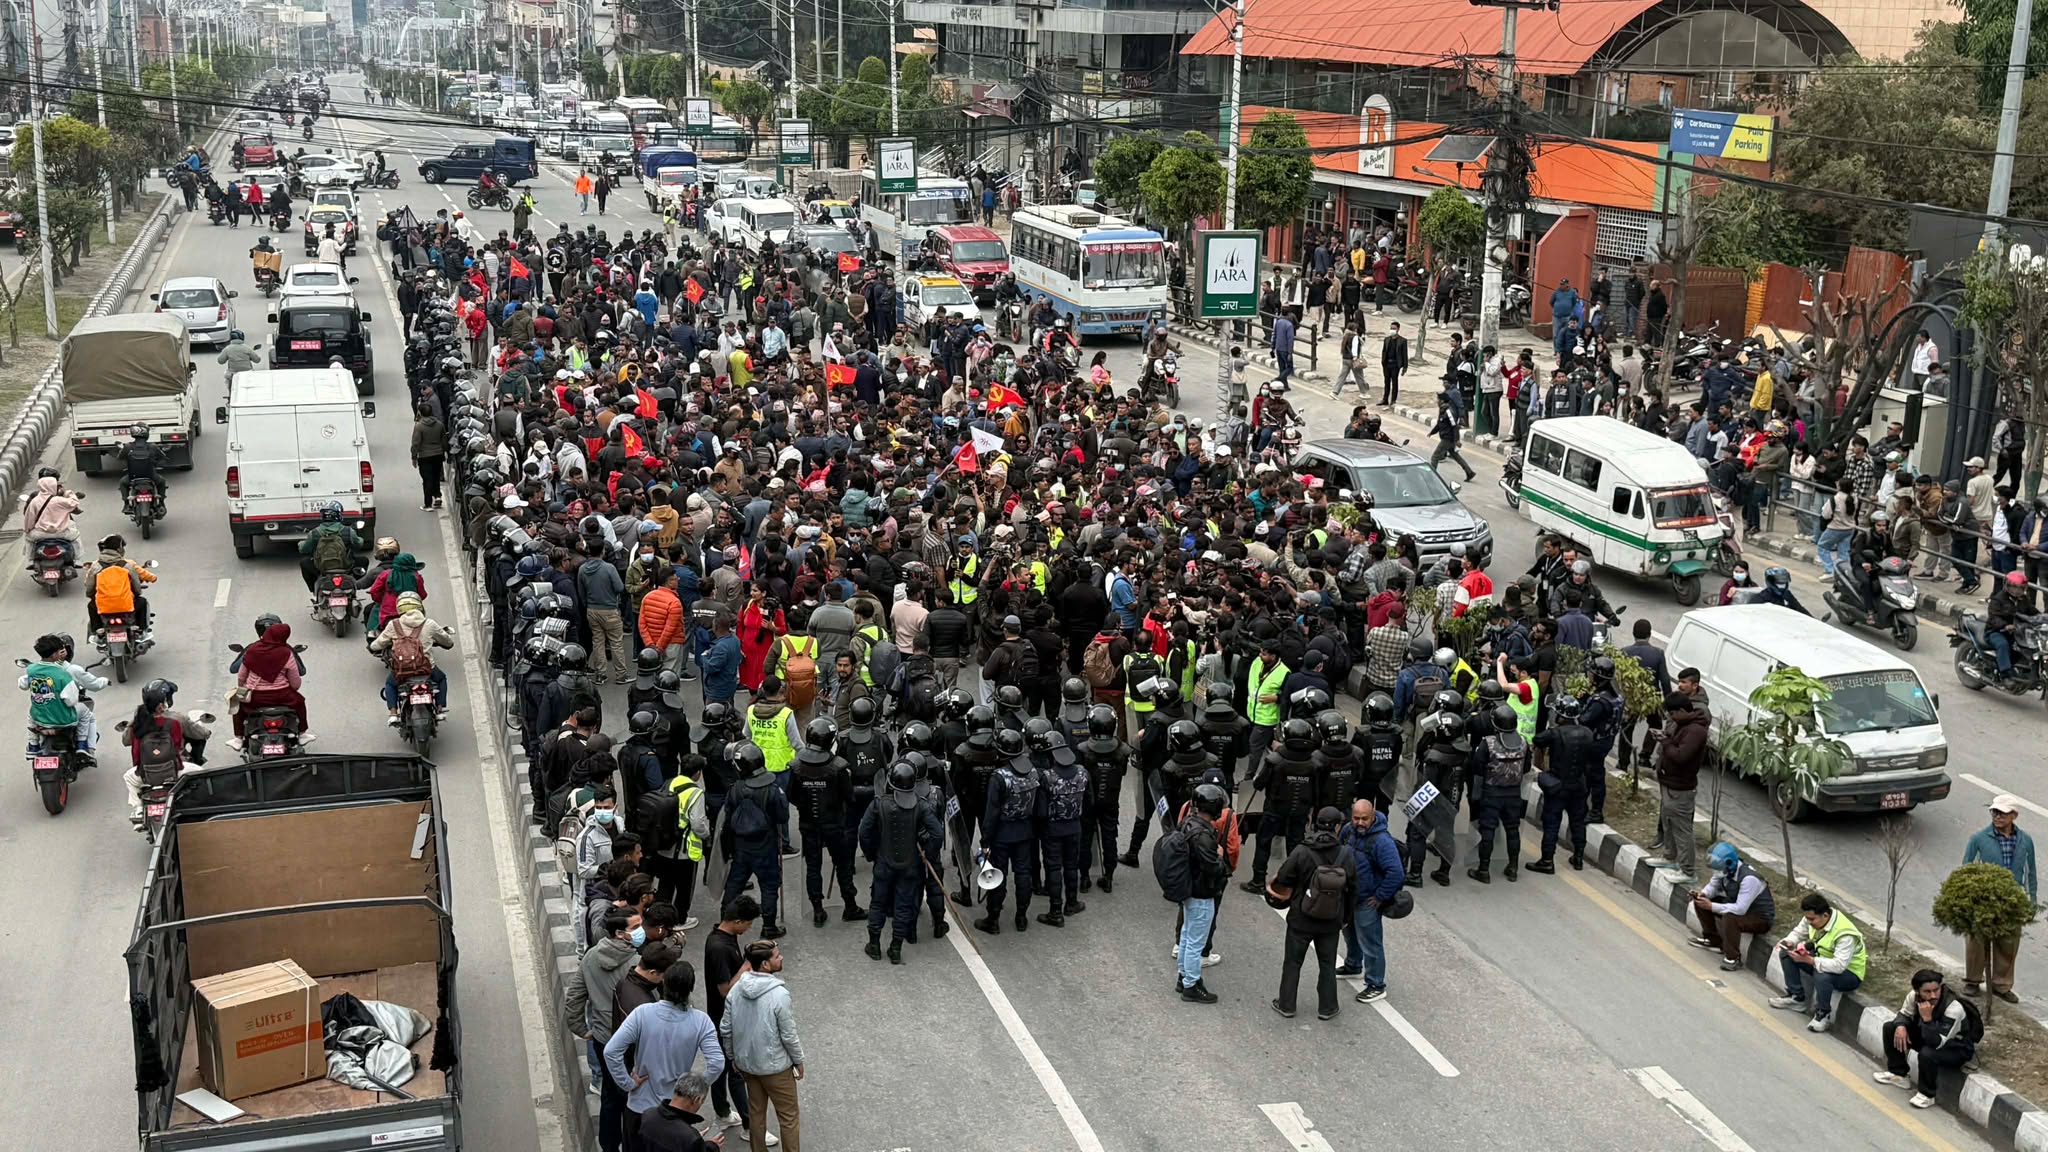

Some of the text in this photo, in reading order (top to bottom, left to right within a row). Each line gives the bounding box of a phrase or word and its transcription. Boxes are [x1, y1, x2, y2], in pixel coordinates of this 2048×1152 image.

[691, 112, 707, 120] JARA
[1748, 125, 1764, 136] Paid
[785, 138, 806, 148] JARA
[1735, 138, 1762, 153] Parking
[887, 161, 909, 172] JARA
[1214, 269, 1248, 284] JARA
[1219, 301, 1238, 310] जरा
[752, 719, 778, 729] PRESS
